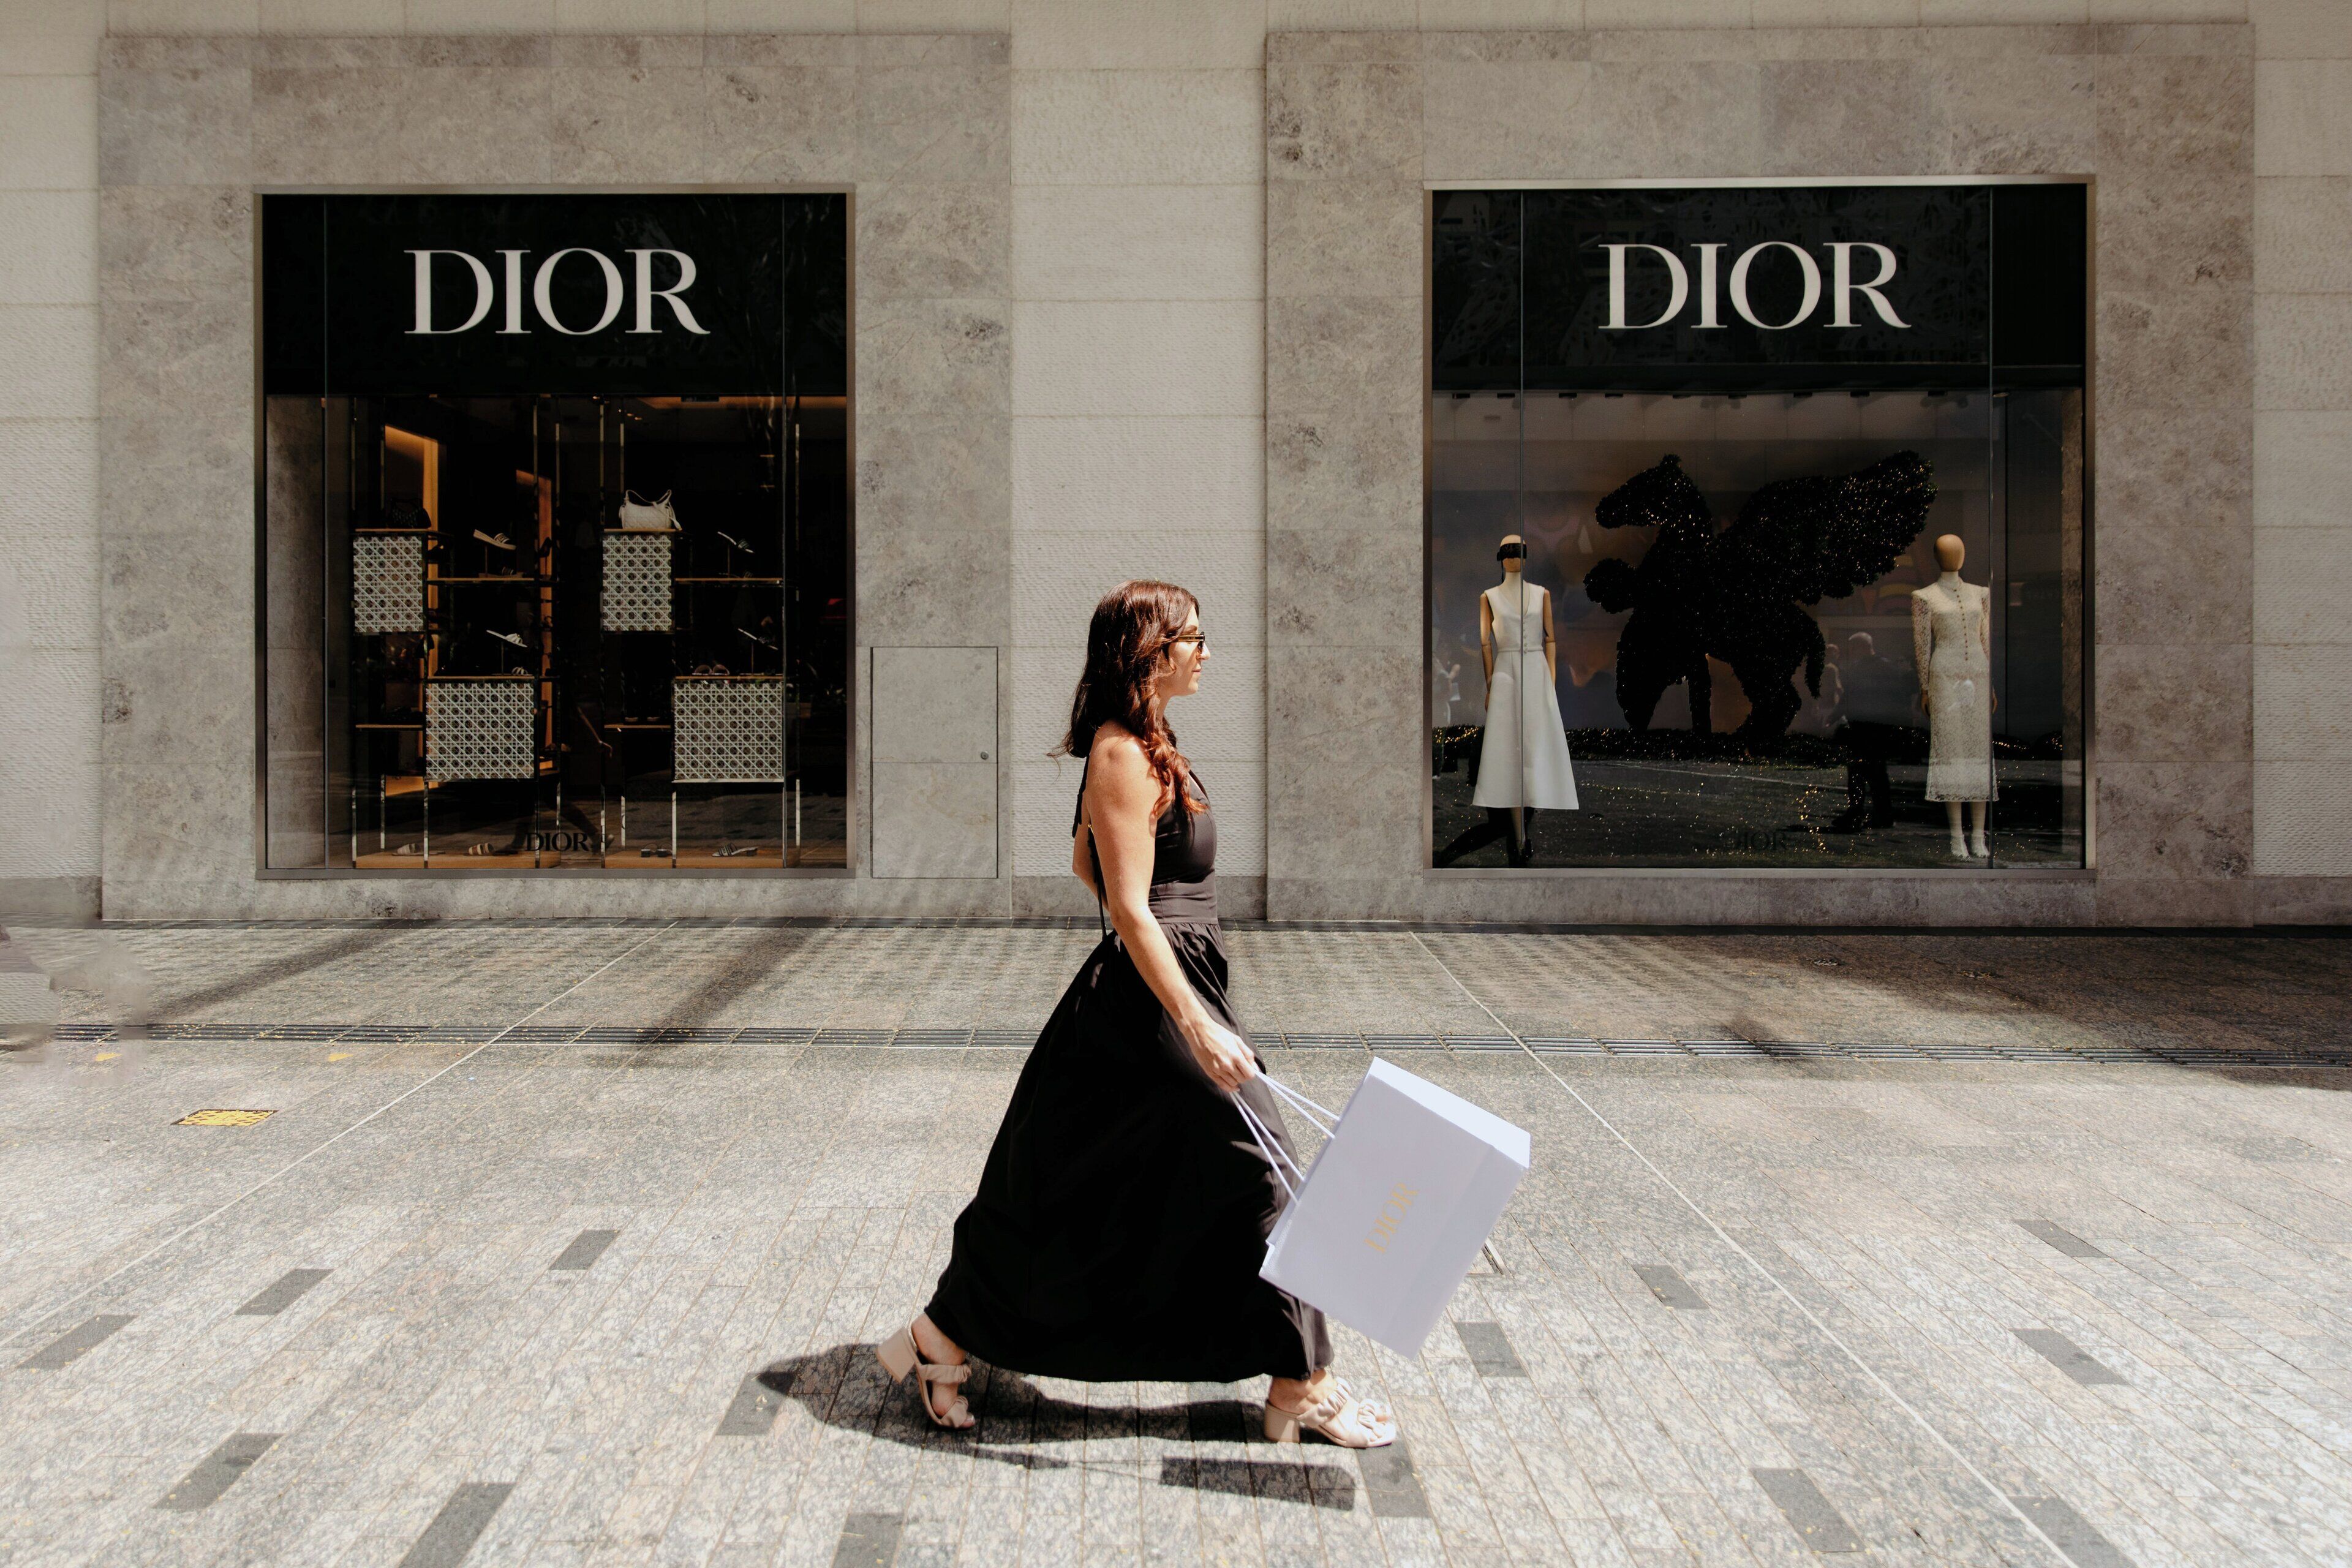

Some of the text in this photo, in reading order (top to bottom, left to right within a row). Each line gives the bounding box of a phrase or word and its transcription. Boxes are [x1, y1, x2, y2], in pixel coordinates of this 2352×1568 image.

[404, 247, 711, 336] DIOR
[1598, 241, 1912, 330] DIOR
[525, 832, 590, 851] DIOR
[1363, 1182, 1420, 1254] DIOR
